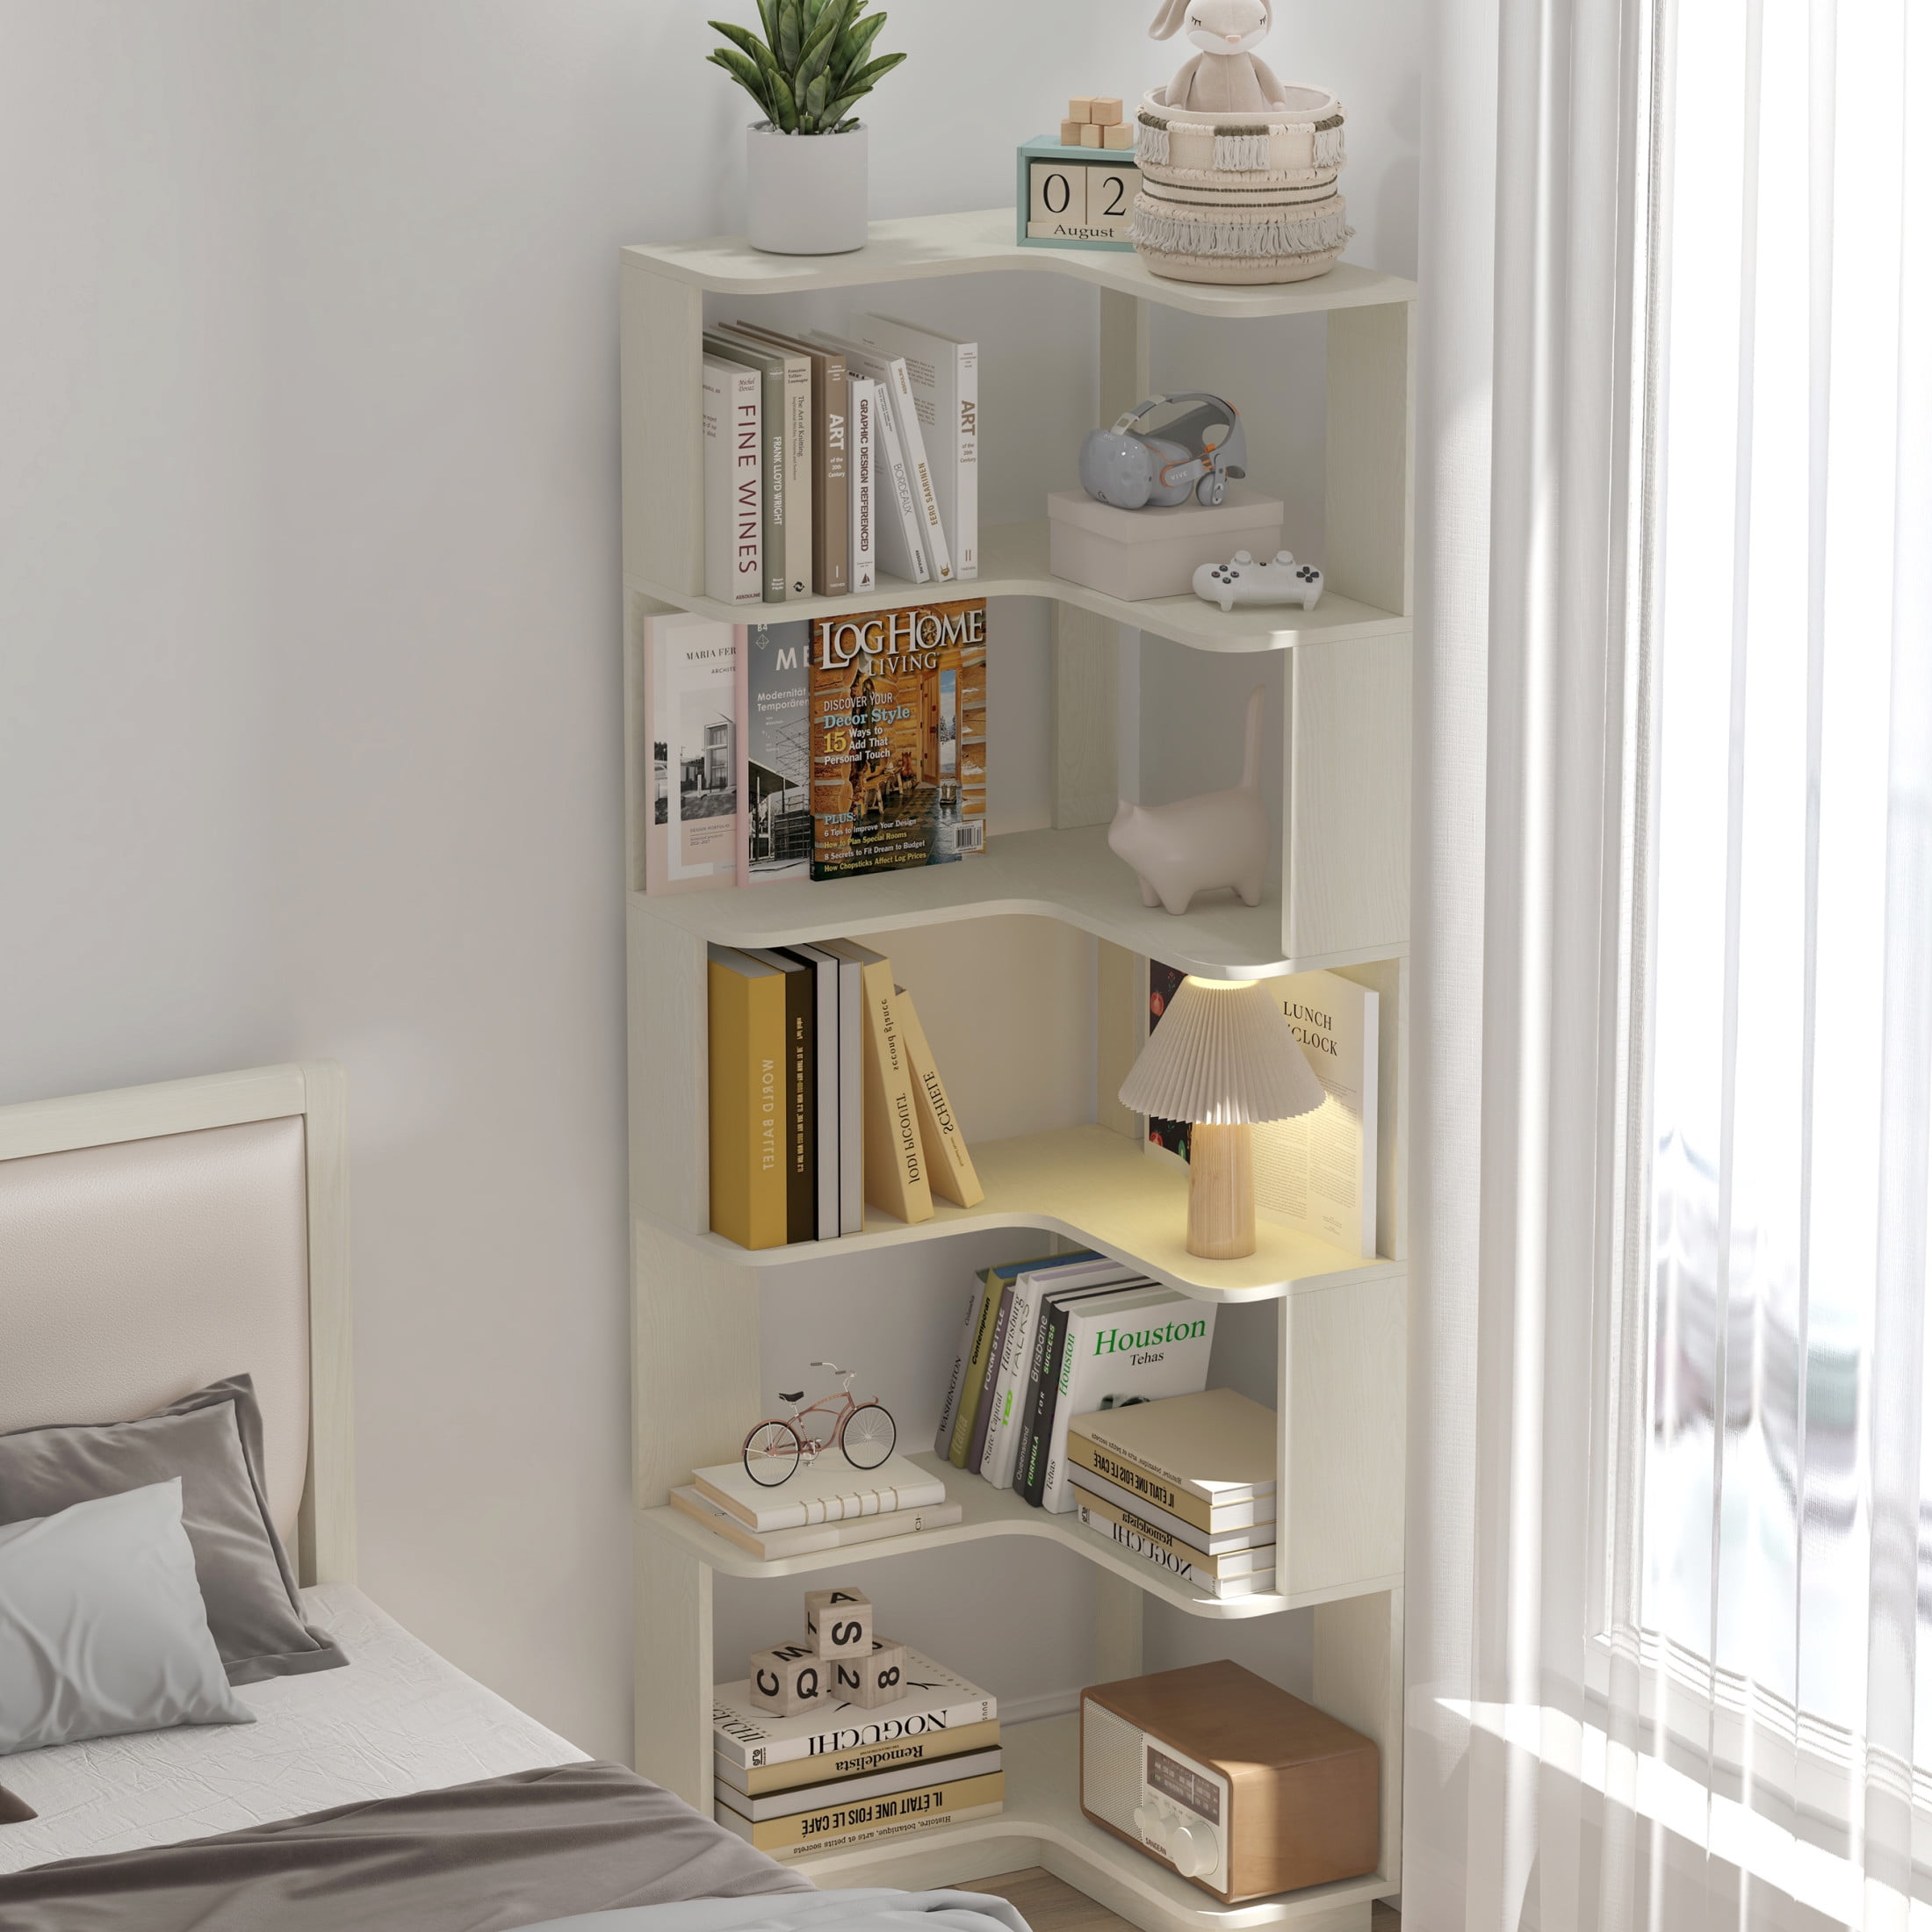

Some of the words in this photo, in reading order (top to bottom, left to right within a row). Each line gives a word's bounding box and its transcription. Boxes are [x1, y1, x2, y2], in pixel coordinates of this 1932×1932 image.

[1054, 223, 1115, 240] August
[860, 399, 869, 444] GRAPHIC
[961, 400, 976, 436] ART
[738, 405, 756, 467] FINE
[829, 414, 845, 450] ART
[773, 436, 782, 463] FRANK
[860, 447, 869, 484] DESIGN
[773, 464, 782, 492] LLOYD
[894, 463, 912, 515] BORDEAUX
[918, 462, 934, 503] SAARINEN
[774, 492, 783, 525] WRIGHT
[927, 505, 939, 526] EERO
[739, 479, 757, 573] WINES
[686, 650, 716, 660] MARIA
[718, 646, 737, 657] FER
[869, 652, 938, 676] LIVING
[757, 687, 806, 702] Modernität
[824, 695, 867, 711] DISCOVER
[869, 692, 893, 705] YOUR
[823, 714, 868, 729] Decor
[870, 704, 911, 724] Style
[823, 731, 847, 753] 15
[848, 727, 871, 739] Ways
[874, 726, 883, 735] to
[849, 739, 866, 751] Add
[869, 737, 889, 747] That
[824, 752, 862, 766] Personal
[865, 748, 890, 761] Touch
[824, 812, 857, 825] PLUS:
[830, 828, 844, 837] Tips
[853, 824, 878, 835] Improve
[880, 821, 894, 830] Your
[895, 818, 917, 828] Design
[830, 851, 854, 860] Secrets
[863, 847, 873, 855] Fit
[874, 844, 894, 854] Dream
[903, 840, 926, 850] Budget
[847, 837, 861, 847] Plan
[862, 834, 884, 845] Special
[886, 831, 907, 840] Rooms
[840, 860, 873, 871] Chopsticks
[874, 856, 893, 866] Affect
[894, 854, 906, 864] Log
[907, 851, 927, 861] Prices
[1284, 1001, 1332, 1031] LUNCH
[984, 1352, 996, 1391] FORM
[991, 1308, 1006, 1349] STYLE
[1092, 1320, 1206, 1356] Houston
[1130, 1352, 1164, 1366] Tehas
[984, 1435, 996, 1464] State
[990, 1393, 1003, 1433] Capital
[1001, 1294, 1025, 1372] Harrisburg
[940, 1355, 962, 1433] WASHINGTON
[1015, 1426, 1030, 1481] Queensland
[1030, 1315, 1048, 1383] Brisbane
[1002, 1390, 1013, 1426] TED
[1027, 1435, 1040, 1488] FORMULA
[1037, 1391, 1046, 1416] FOR
[1042, 1324, 1056, 1375] SUCCESS
[1045, 1460, 1056, 1490] Tehas
[1057, 1333, 1076, 1397] Houston
[830, 1591, 860, 1604] A
[831, 1621, 862, 1646] S
[756, 1669, 780, 1697] C
[797, 1668, 818, 1699] Q
[838, 1664, 861, 1690] 2
[877, 1666, 900, 1689] 8
[808, 1710, 948, 1756] NOGUCHI
[835, 1744, 925, 1771] Remodelista
[900, 1794, 930, 1814] ÉTAIT
[933, 1791, 942, 1806] IL
[833, 1812, 845, 1829] LE
[848, 1806, 872, 1825] FOIS
[875, 1801, 897, 1820] UNE
[919, 1815, 951, 1827] Histoire,
[801, 1815, 830, 1838] CAFÉ
[857, 1832, 875, 1841] arts
[876, 1821, 916, 1836] botanique,
[793, 1842, 822, 1854] secrets
[824, 1836, 846, 1849] petits
